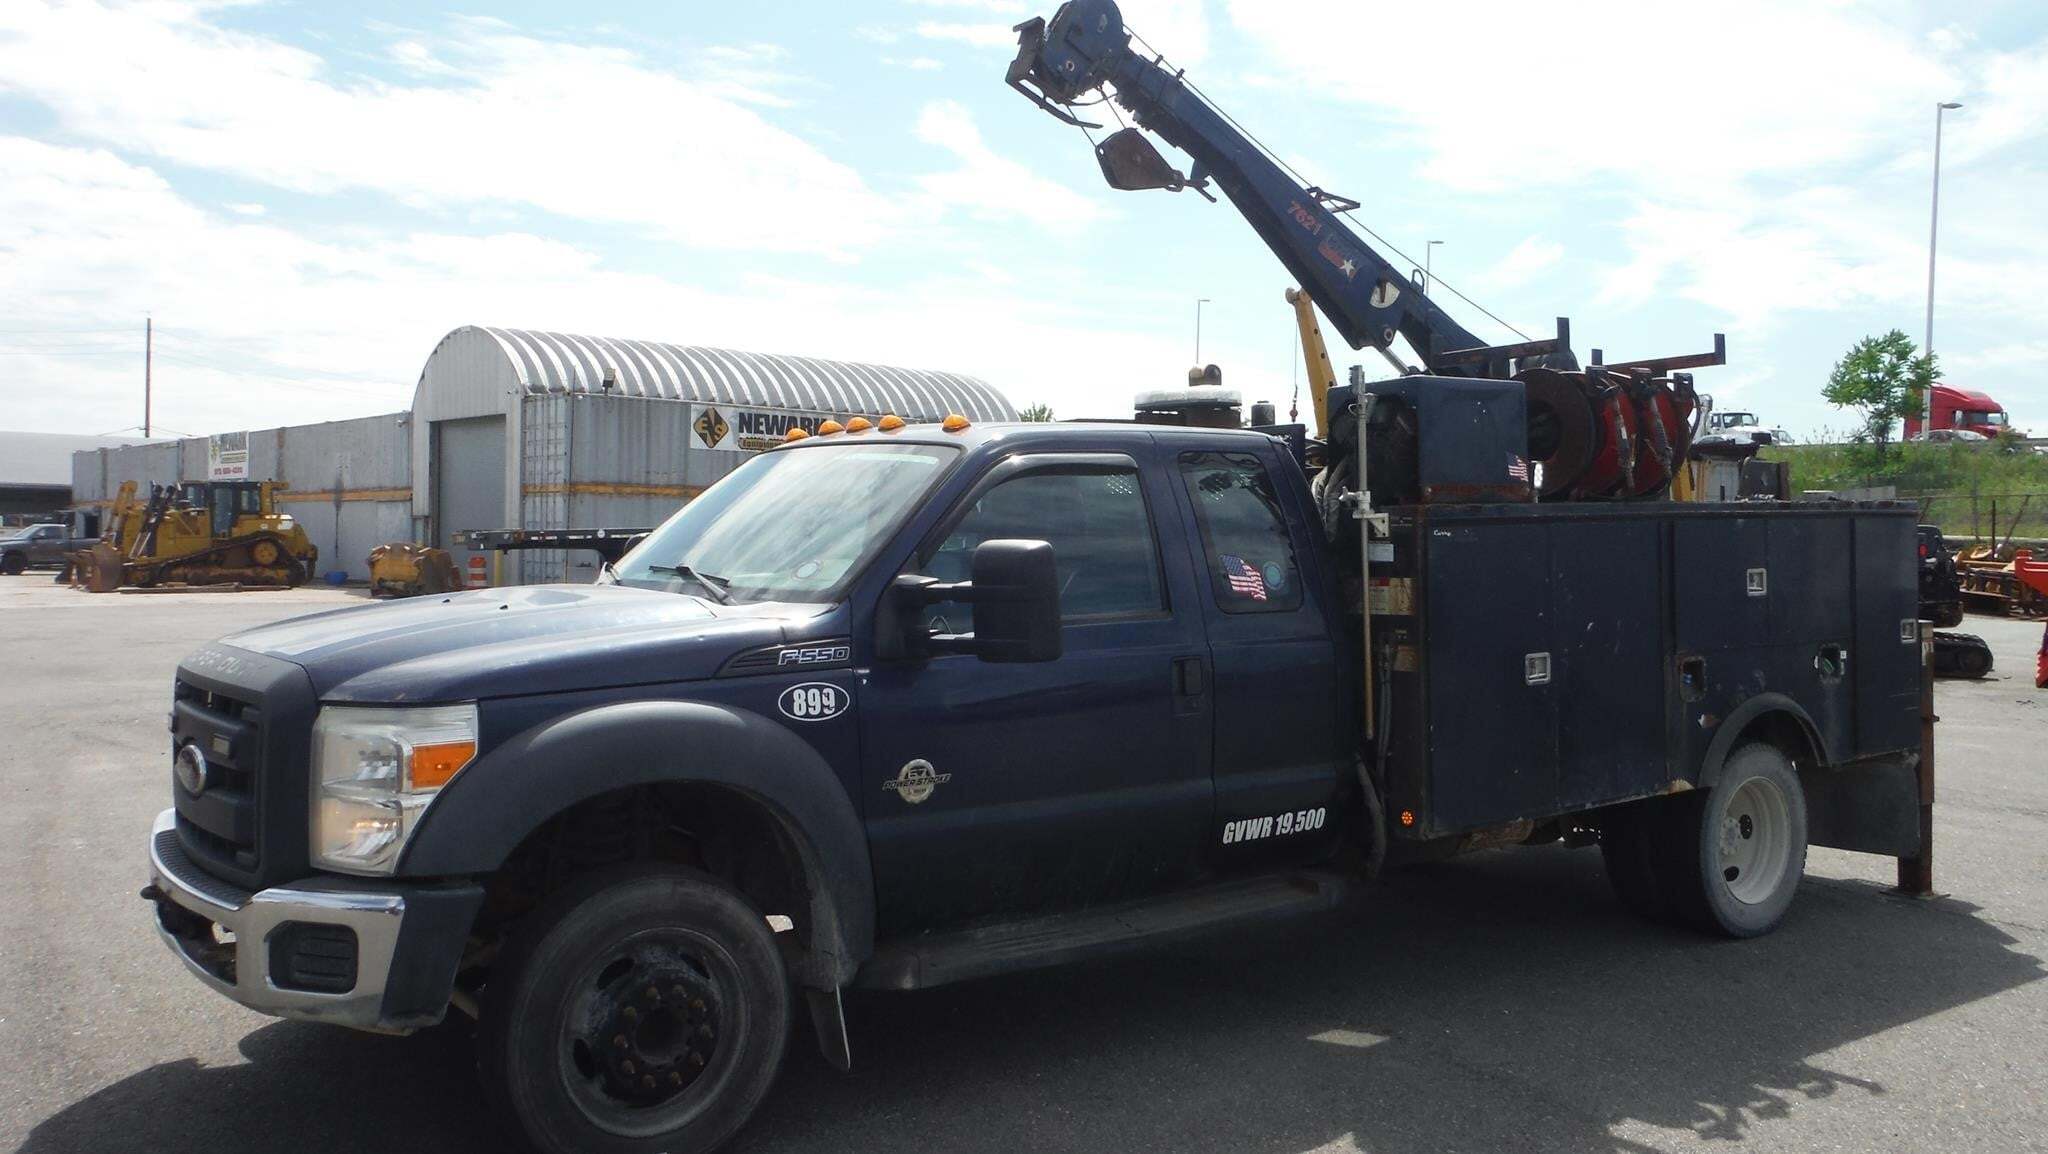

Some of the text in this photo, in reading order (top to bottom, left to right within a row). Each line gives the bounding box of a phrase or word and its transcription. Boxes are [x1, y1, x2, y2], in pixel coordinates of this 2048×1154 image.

[778, 647, 850, 665] F-550
[793, 688, 836, 716] 899
[1222, 807, 1326, 844] GVWR 19,500
